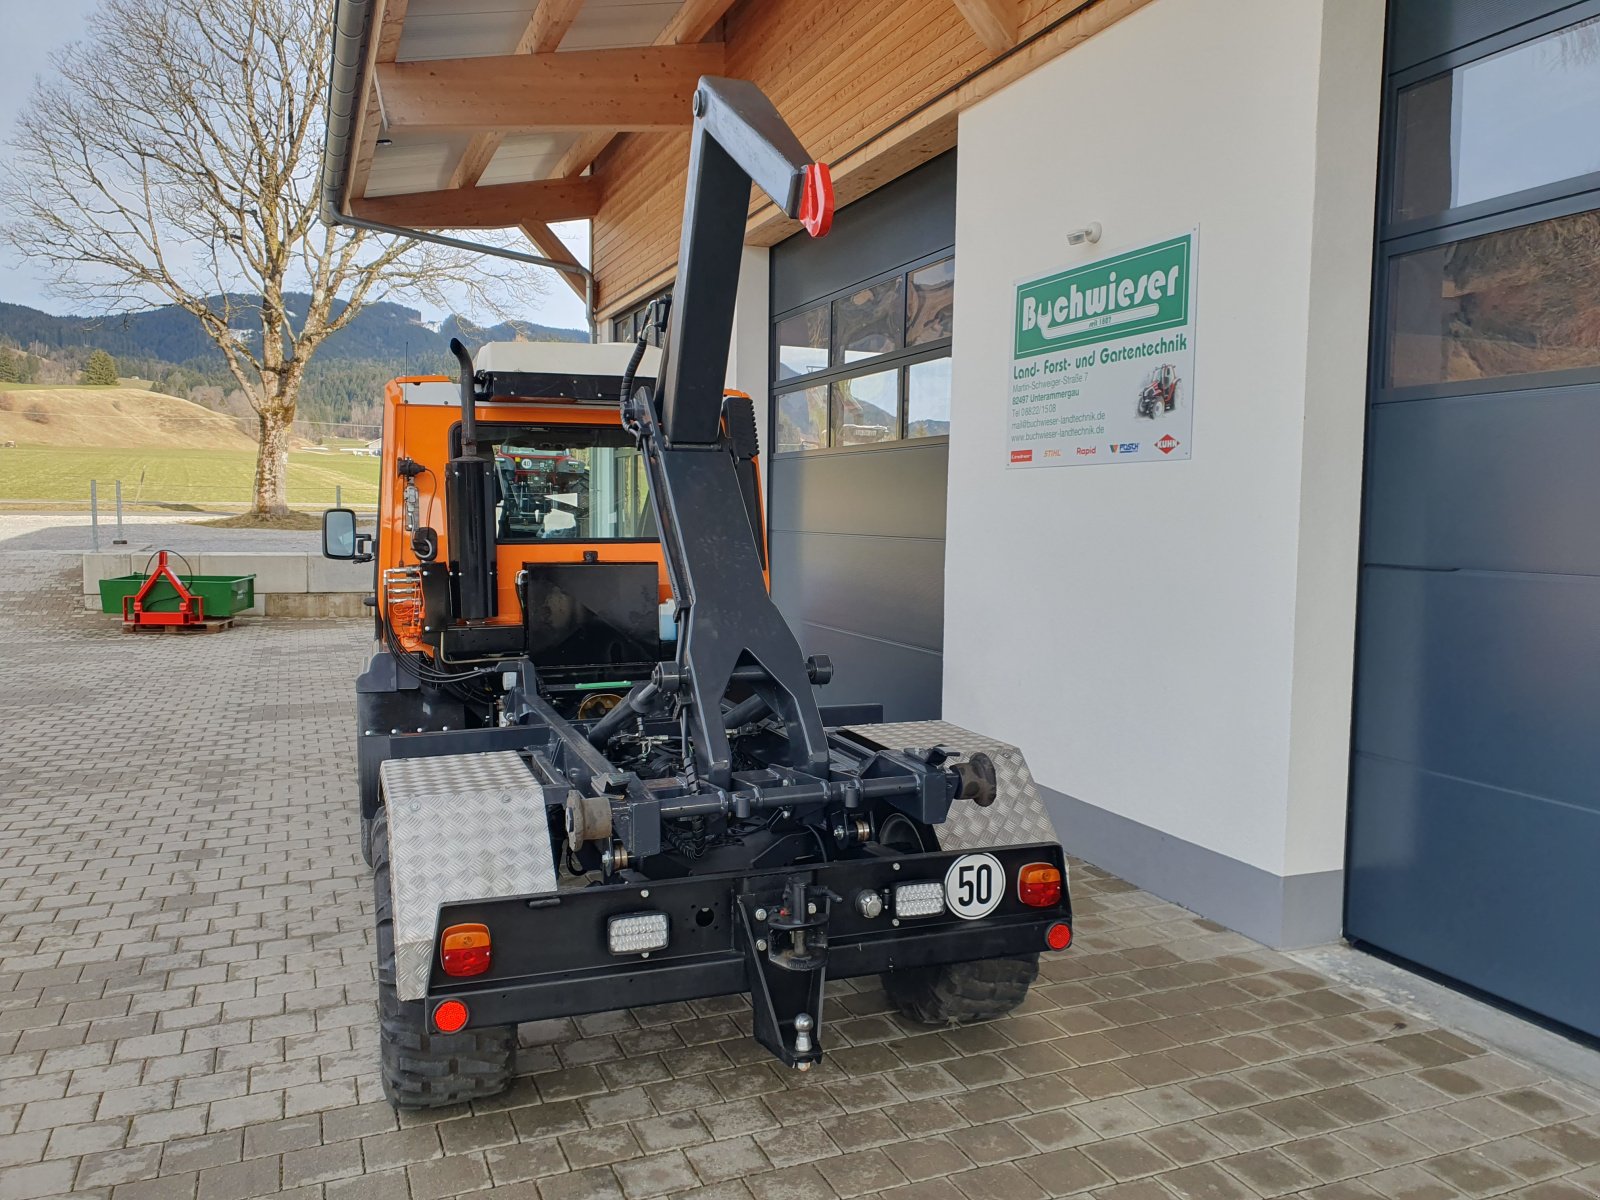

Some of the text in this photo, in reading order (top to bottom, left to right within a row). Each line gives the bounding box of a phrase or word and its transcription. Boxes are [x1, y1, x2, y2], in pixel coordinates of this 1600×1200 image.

[1022, 265, 1179, 332] Buchwieser
[1014, 334, 1188, 380] Land- Forst- und Gartentechnik
[1084, 372, 1089, 382] 7
[1030, 389, 1080, 402] Unterammergau
[1011, 425, 1105, 442] www.buchwieser-landtechnik.de
[1076, 446, 1097, 456] Rapid
[958, 864, 992, 906] 50
